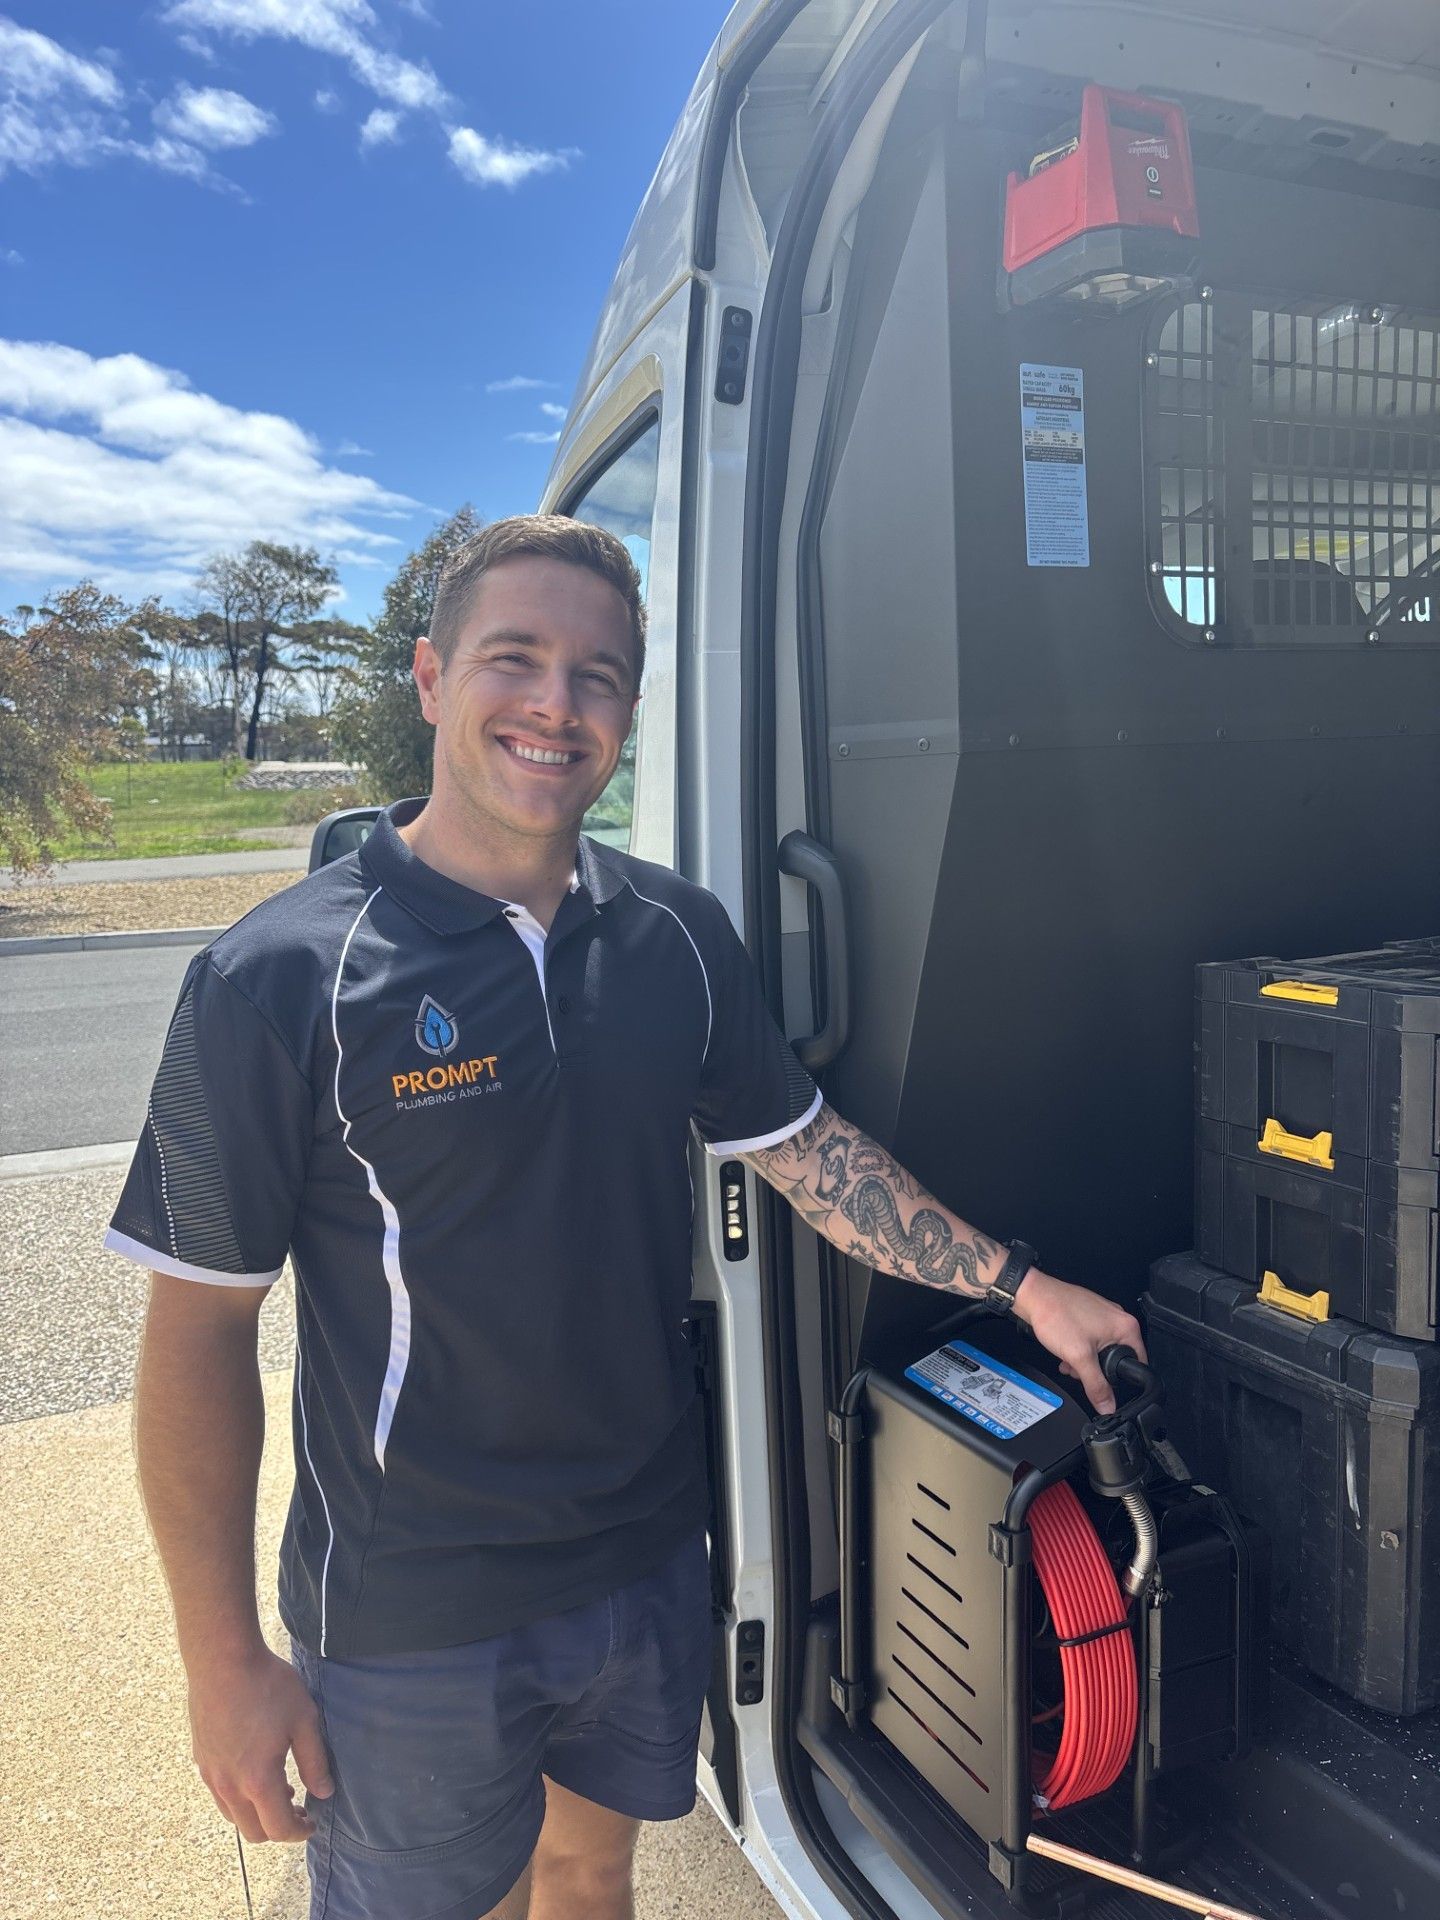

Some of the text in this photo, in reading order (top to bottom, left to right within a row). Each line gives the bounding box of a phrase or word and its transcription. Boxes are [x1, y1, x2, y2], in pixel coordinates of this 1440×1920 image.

[1058, 384, 1075, 396] 60kg
[391, 1055, 498, 1098] PROMPT
[395, 1081, 503, 1111] PLUMBING AND AIR
